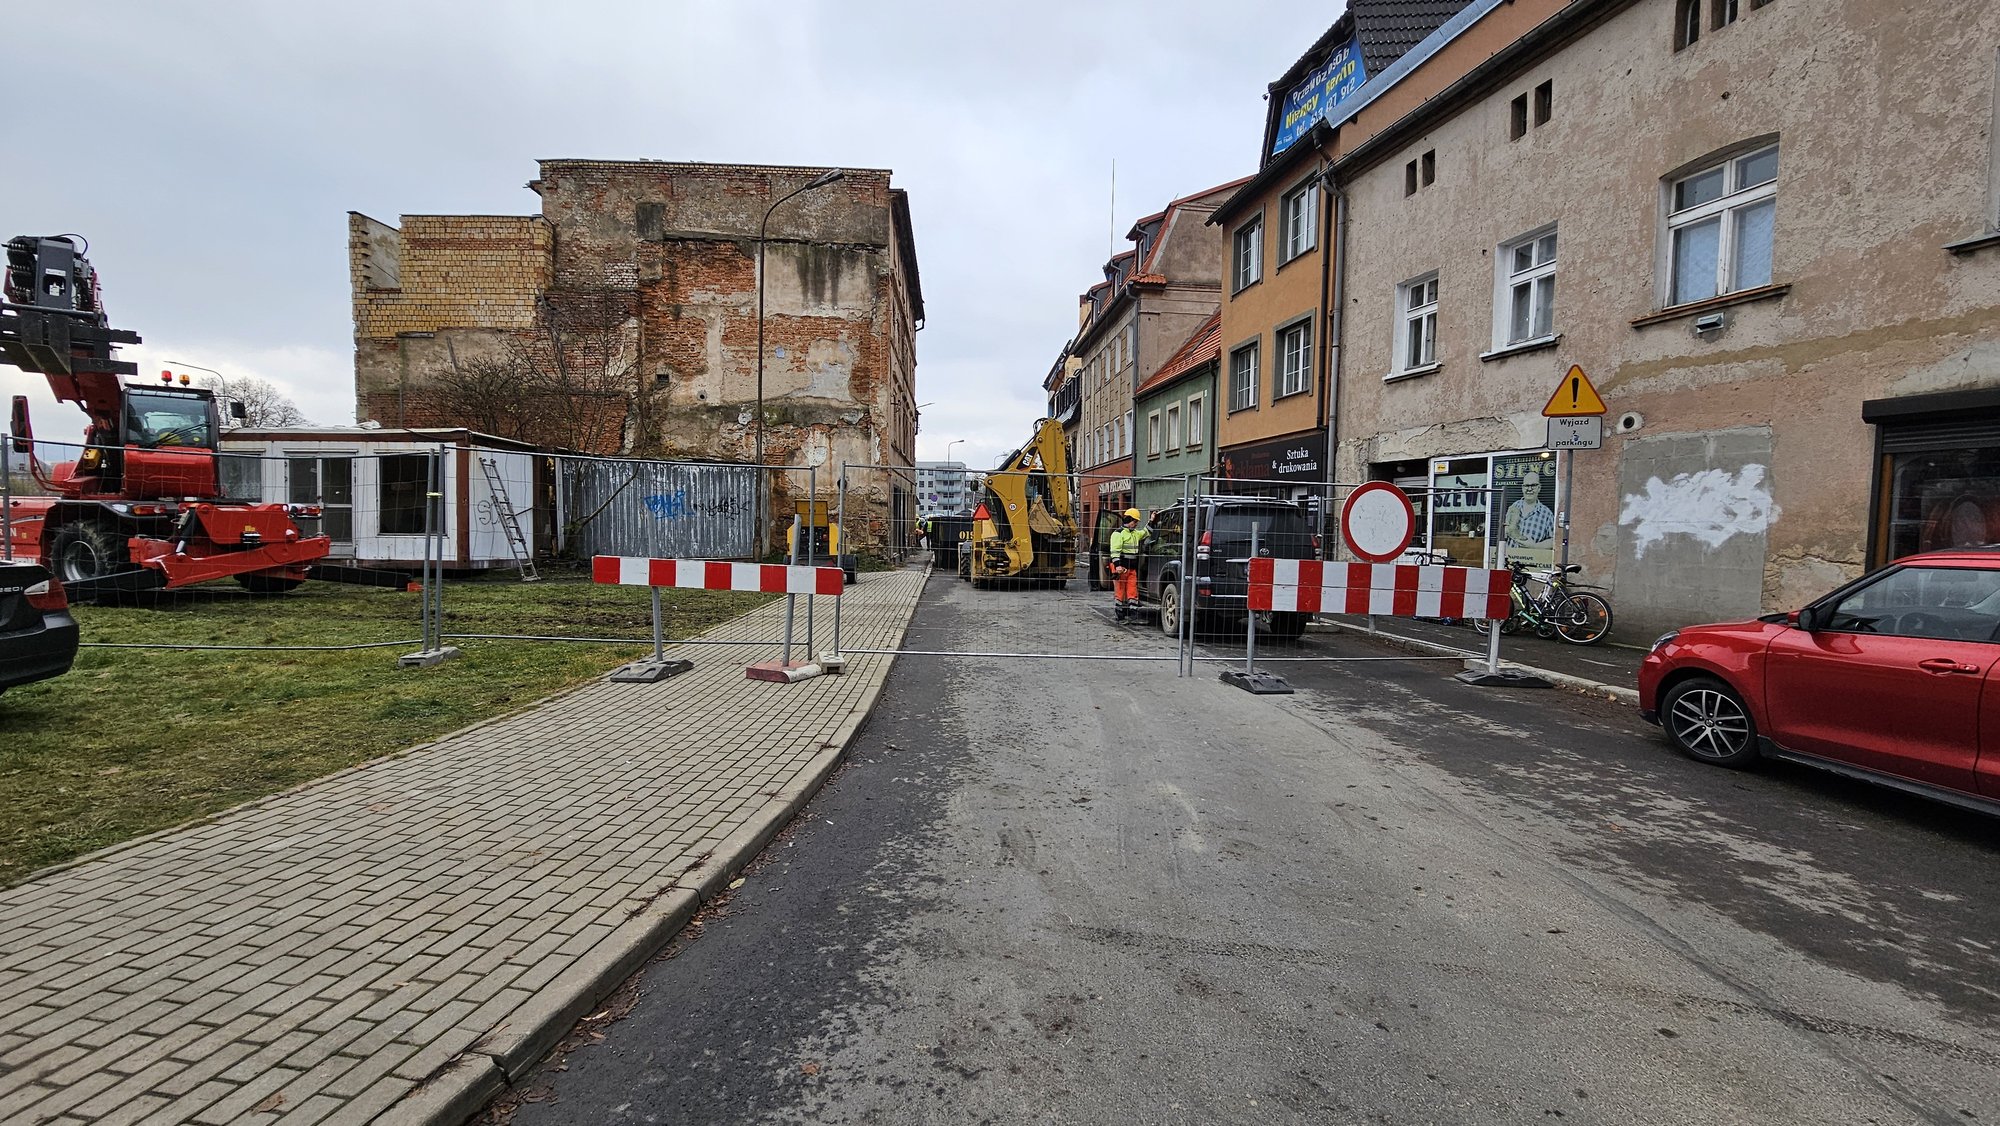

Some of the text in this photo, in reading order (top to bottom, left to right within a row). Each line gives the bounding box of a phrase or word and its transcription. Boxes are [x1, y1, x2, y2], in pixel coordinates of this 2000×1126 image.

[1292, 71, 1328, 105] Przewóz
[1560, 418, 1589, 427] Wyjazd
[1556, 439, 1593, 447] parkingu
[1022, 452, 1033, 466] CAT
[1286, 447, 1309, 460] Sztuka
[1278, 460, 1317, 474] drukowania
[1494, 461, 1556, 479] SZEWC
